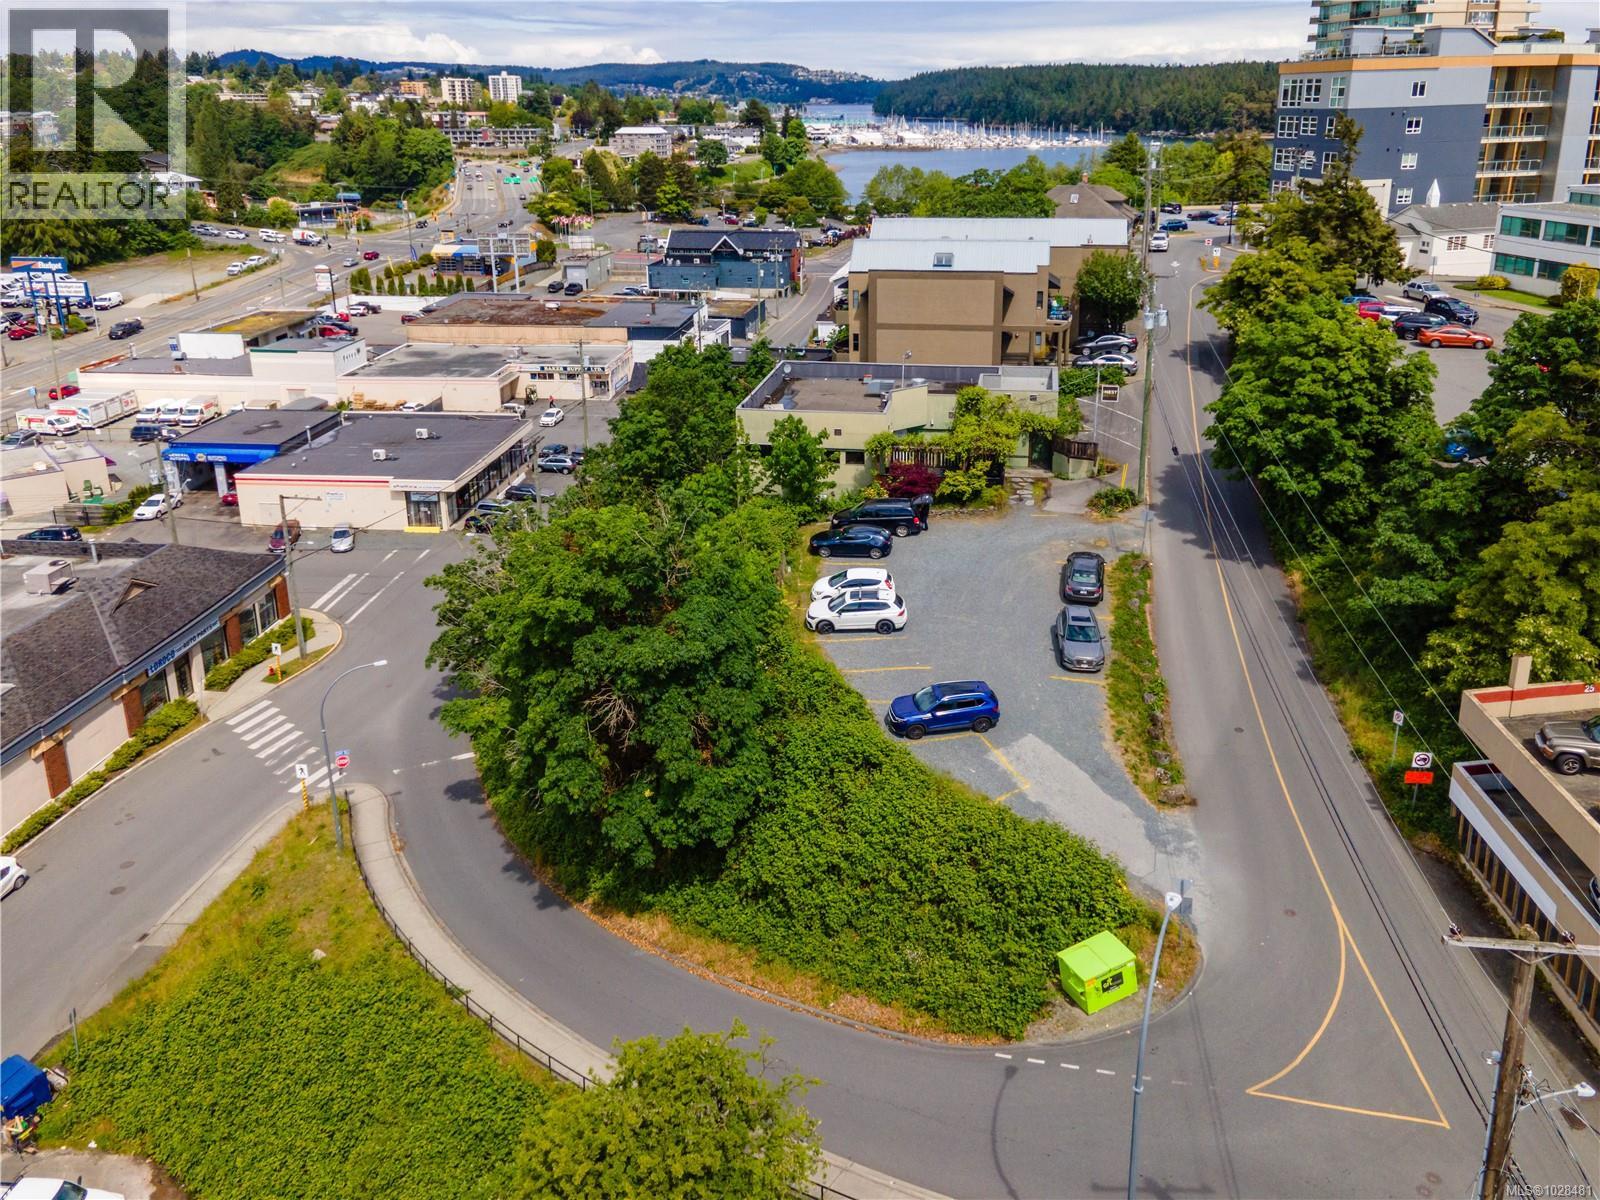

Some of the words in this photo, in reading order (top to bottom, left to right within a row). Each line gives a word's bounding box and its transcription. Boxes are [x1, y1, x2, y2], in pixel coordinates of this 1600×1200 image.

[38, 260, 64, 271] Budget
[149, 649, 177, 673] LORDCO
[183, 635, 197, 648] AUTO
[197, 625, 213, 639] PARTS
